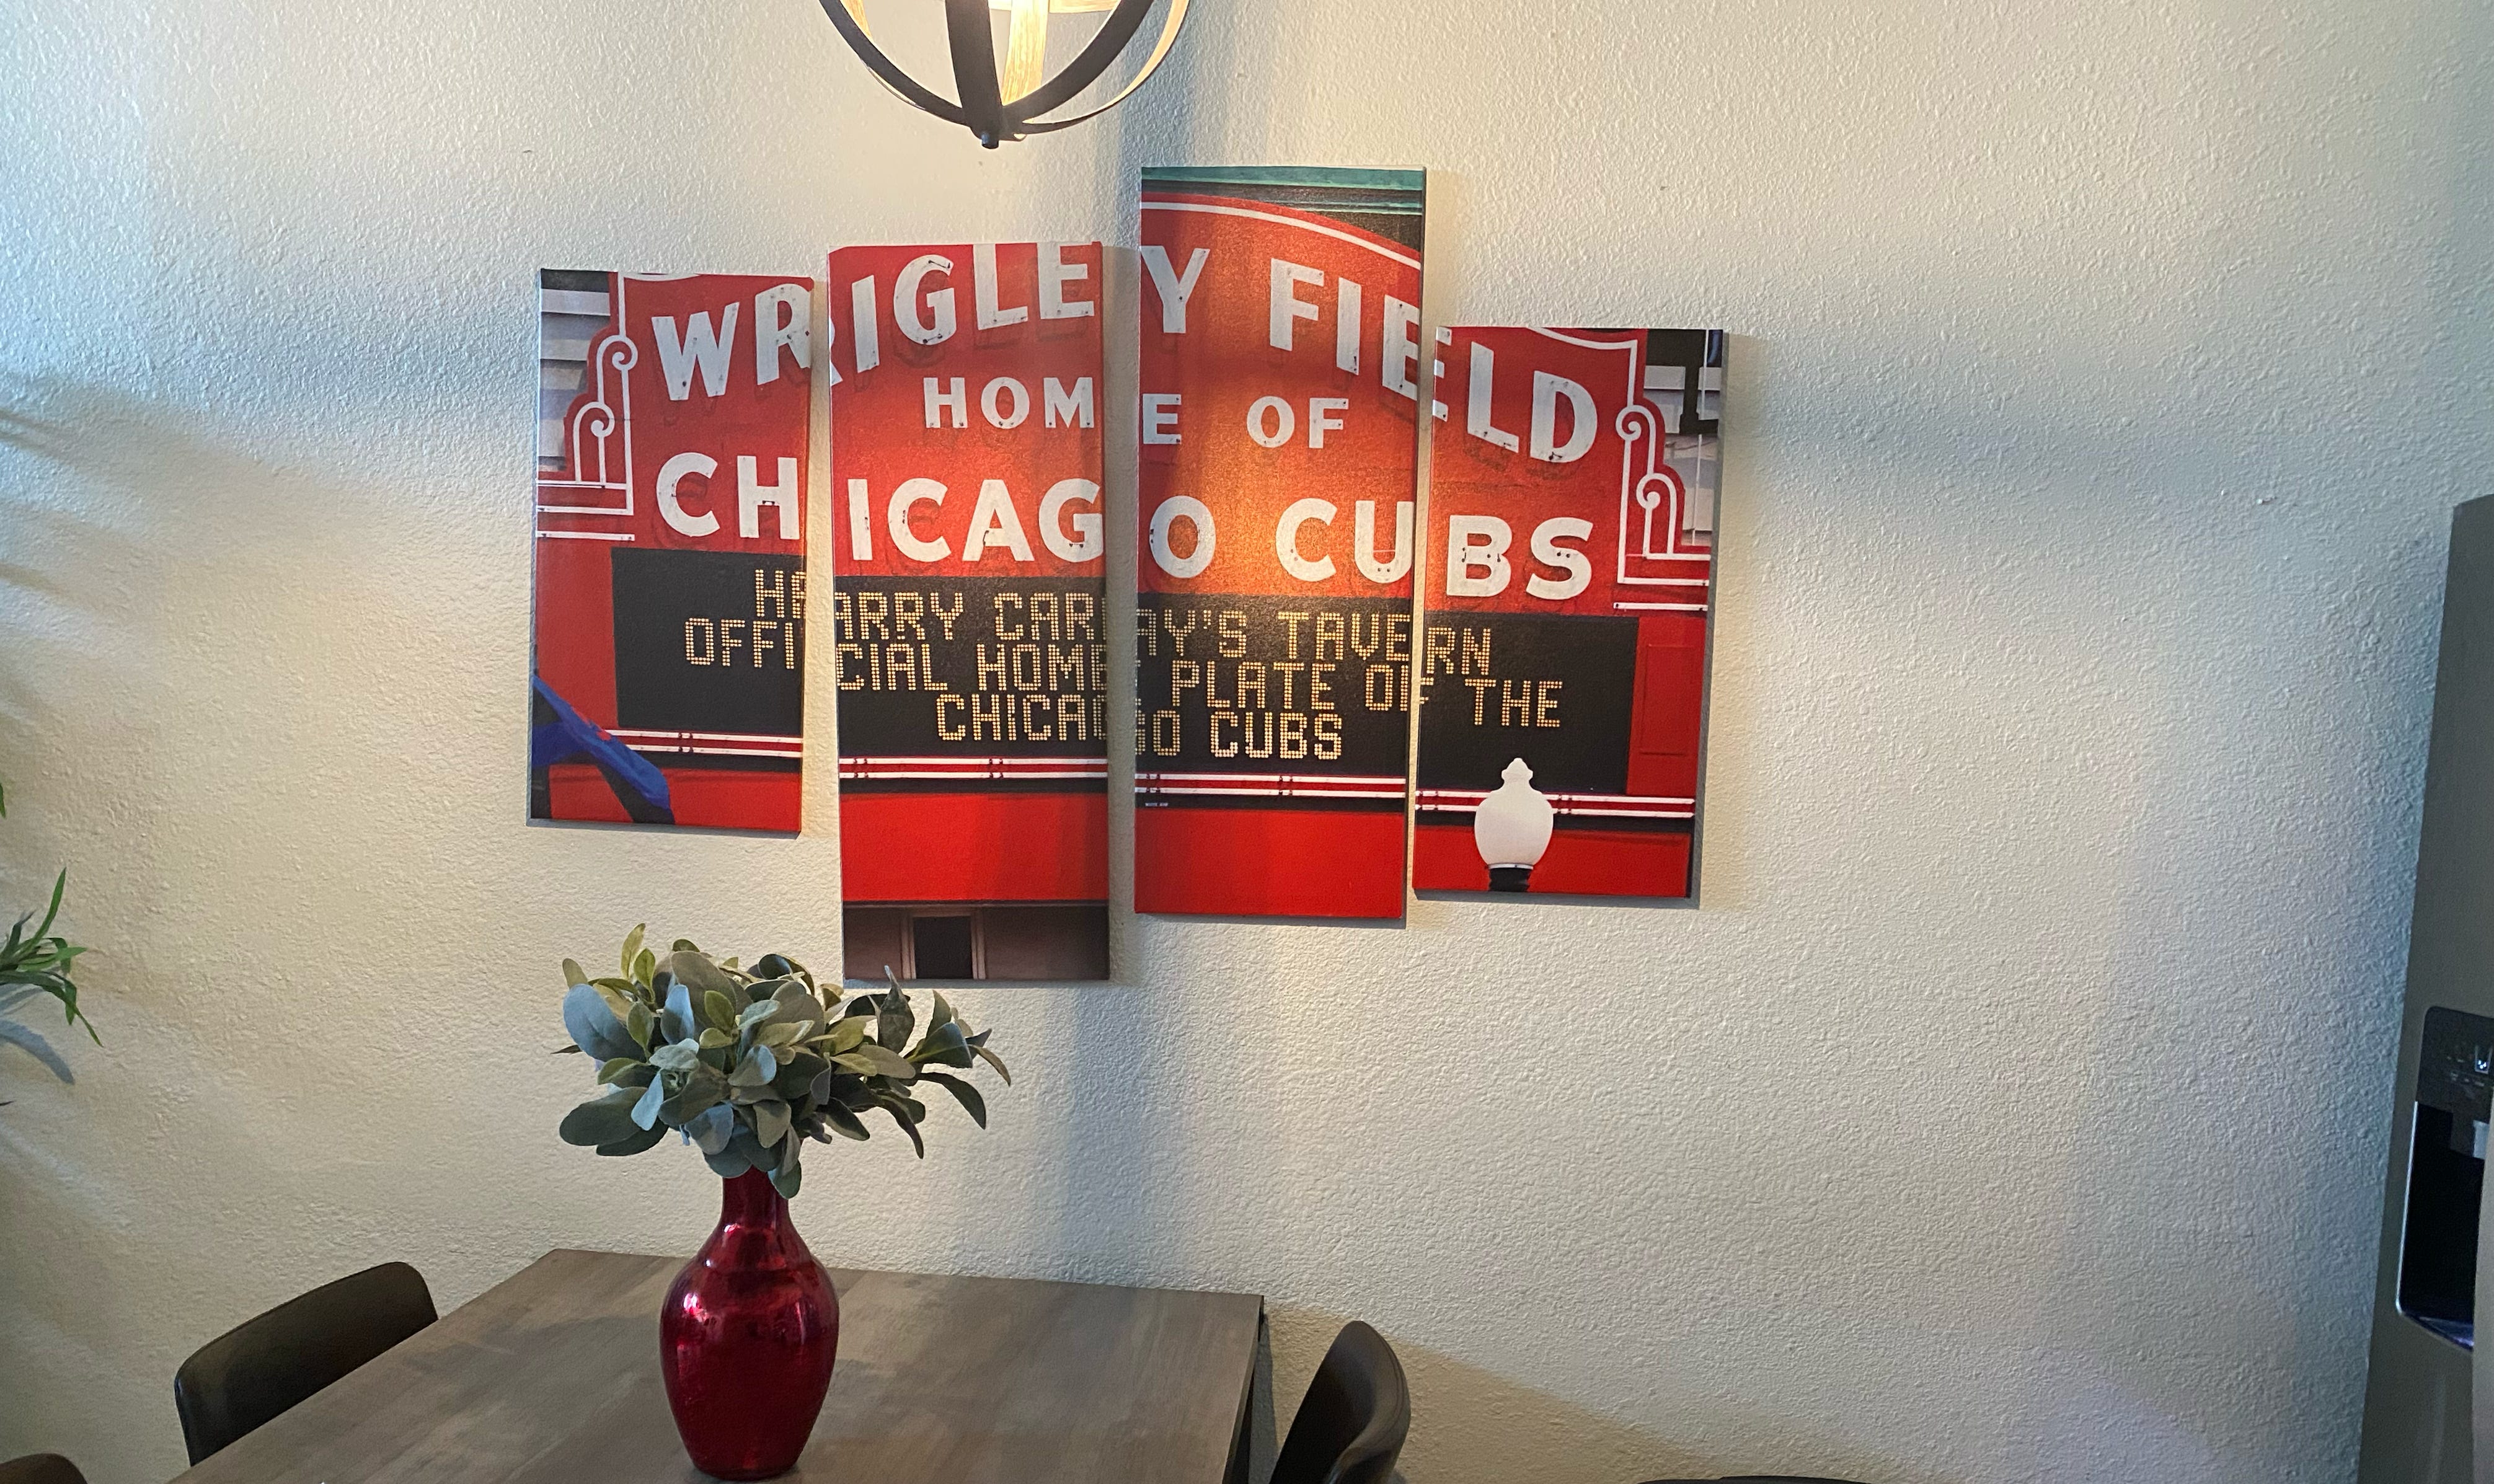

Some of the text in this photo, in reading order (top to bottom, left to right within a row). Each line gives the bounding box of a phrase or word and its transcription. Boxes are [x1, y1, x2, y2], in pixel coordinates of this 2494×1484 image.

[1247, 395, 1349, 448] OF
[1172, 660, 1335, 709] PLATE
[1464, 678, 1563, 728] THE
[1210, 711, 1342, 760] CUBS
